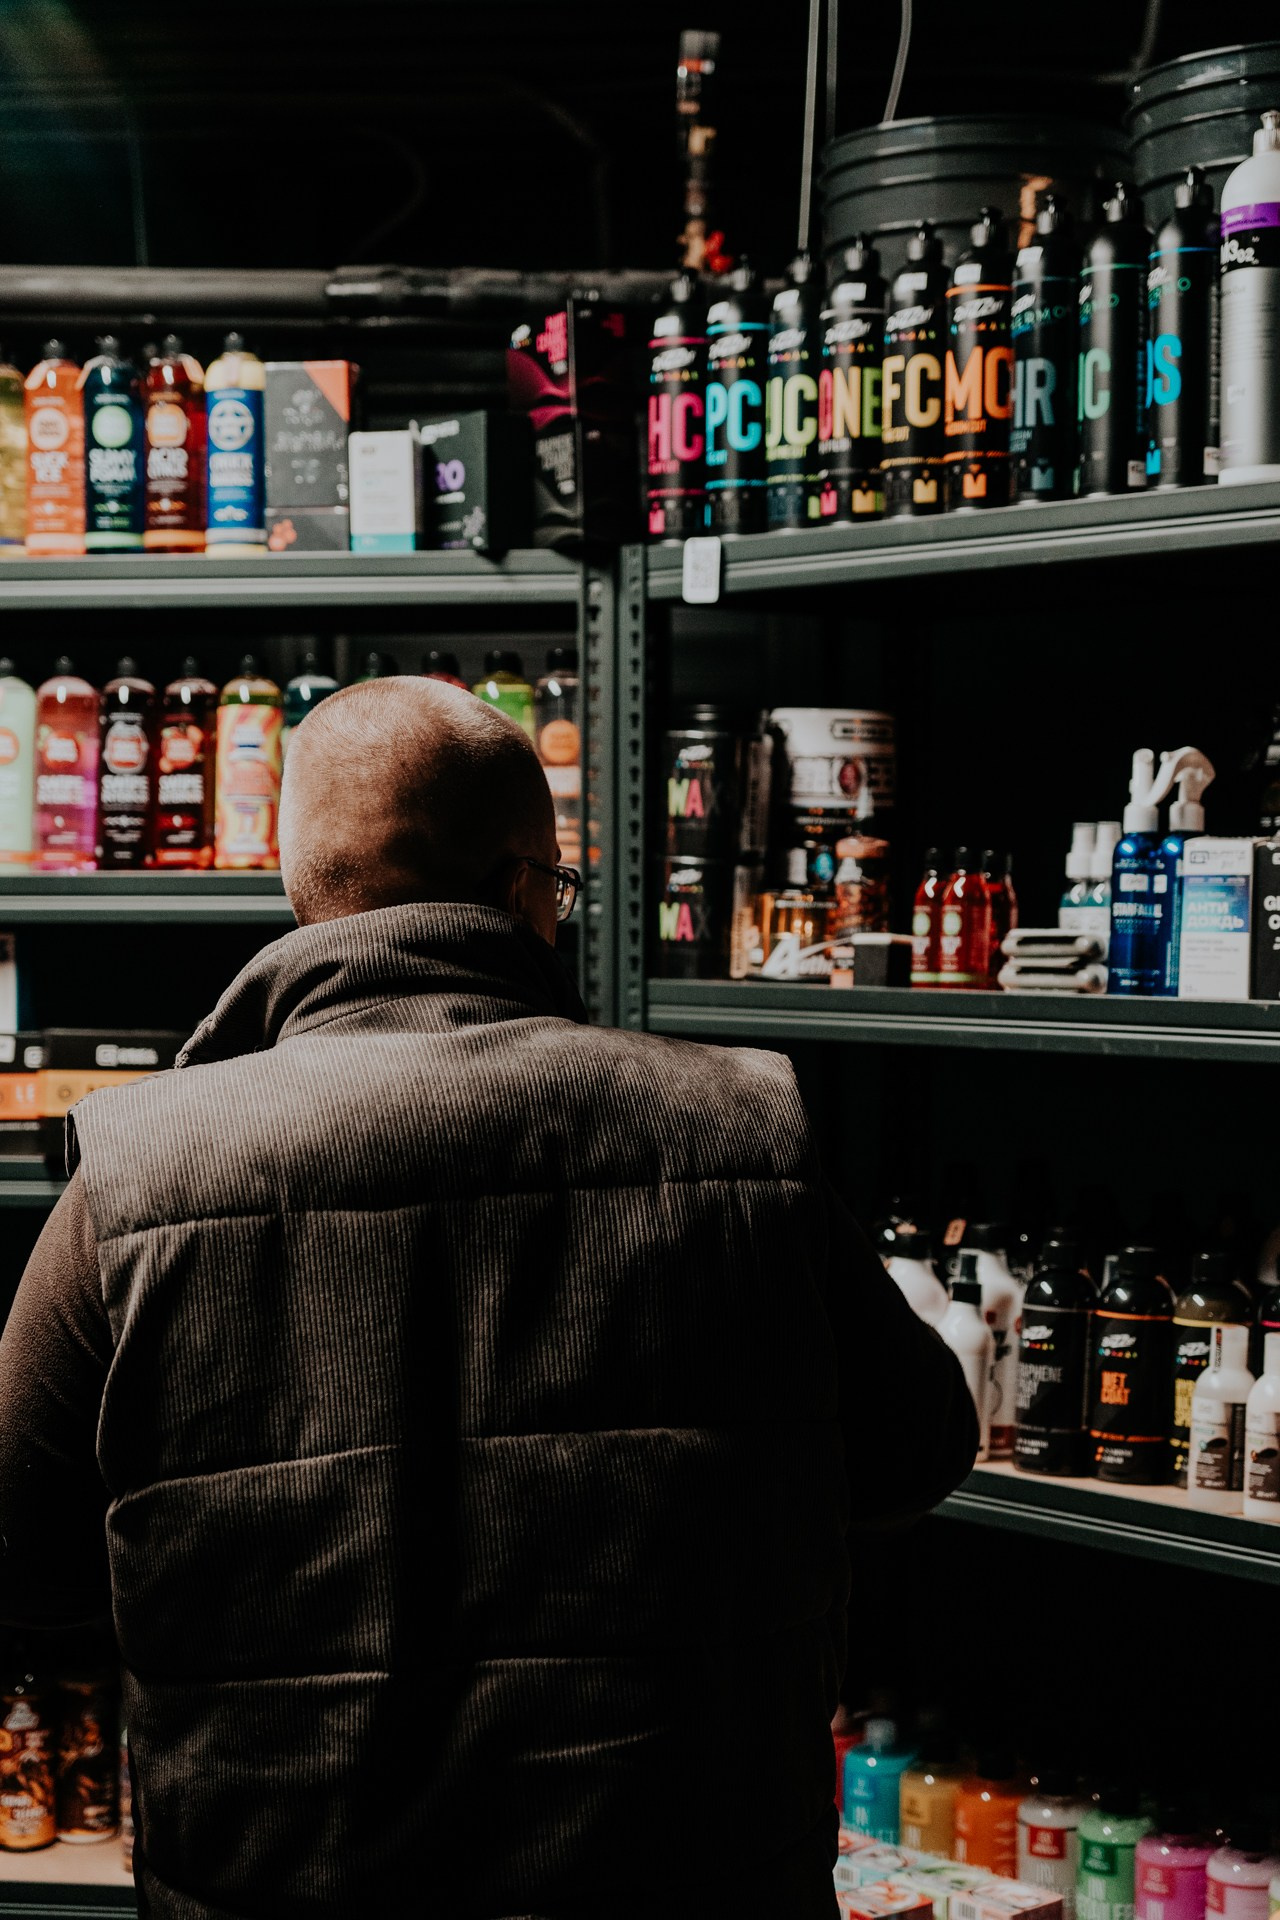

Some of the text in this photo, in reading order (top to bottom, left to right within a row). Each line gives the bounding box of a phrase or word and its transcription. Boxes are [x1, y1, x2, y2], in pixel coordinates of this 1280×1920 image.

[648, 391, 704, 465] HC
[705, 379, 762, 454] PC
[881, 352, 942, 430] FC
[1187, 902, 1229, 914] АНТИ
